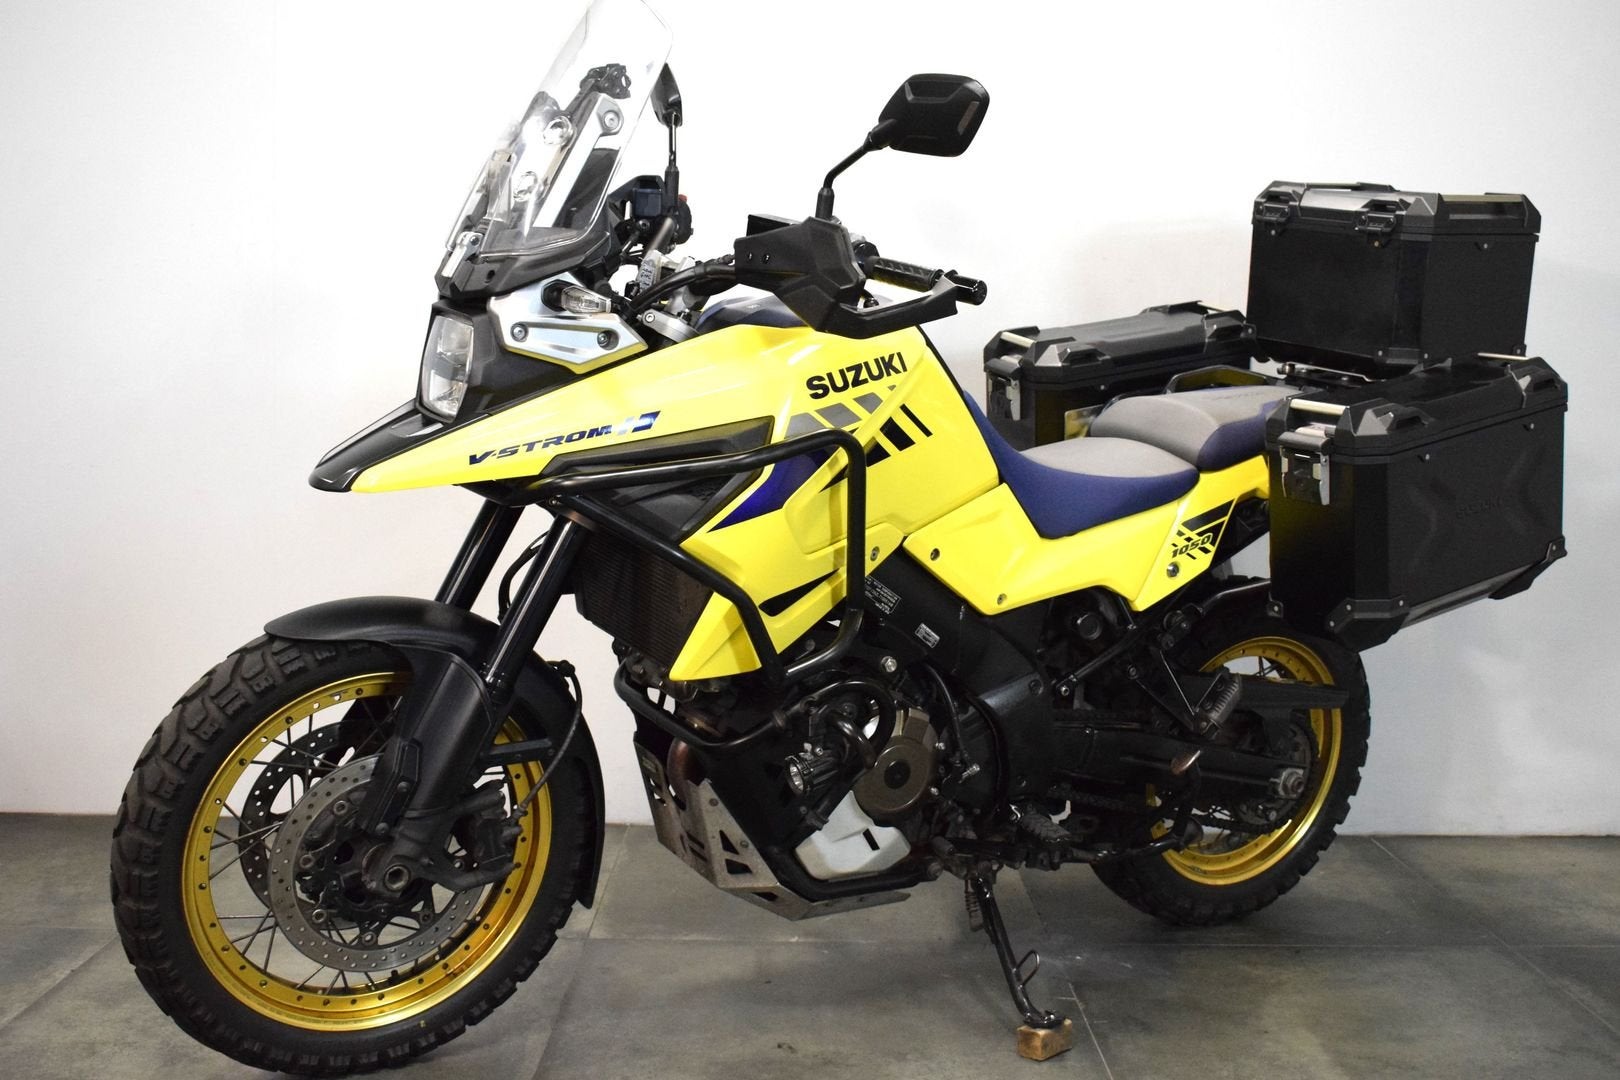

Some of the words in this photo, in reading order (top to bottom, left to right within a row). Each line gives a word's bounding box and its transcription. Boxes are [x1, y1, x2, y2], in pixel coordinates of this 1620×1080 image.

[807, 352, 908, 399] SUZUKI
[469, 424, 613, 465] V-STROM
[1172, 534, 1212, 559] 1050
